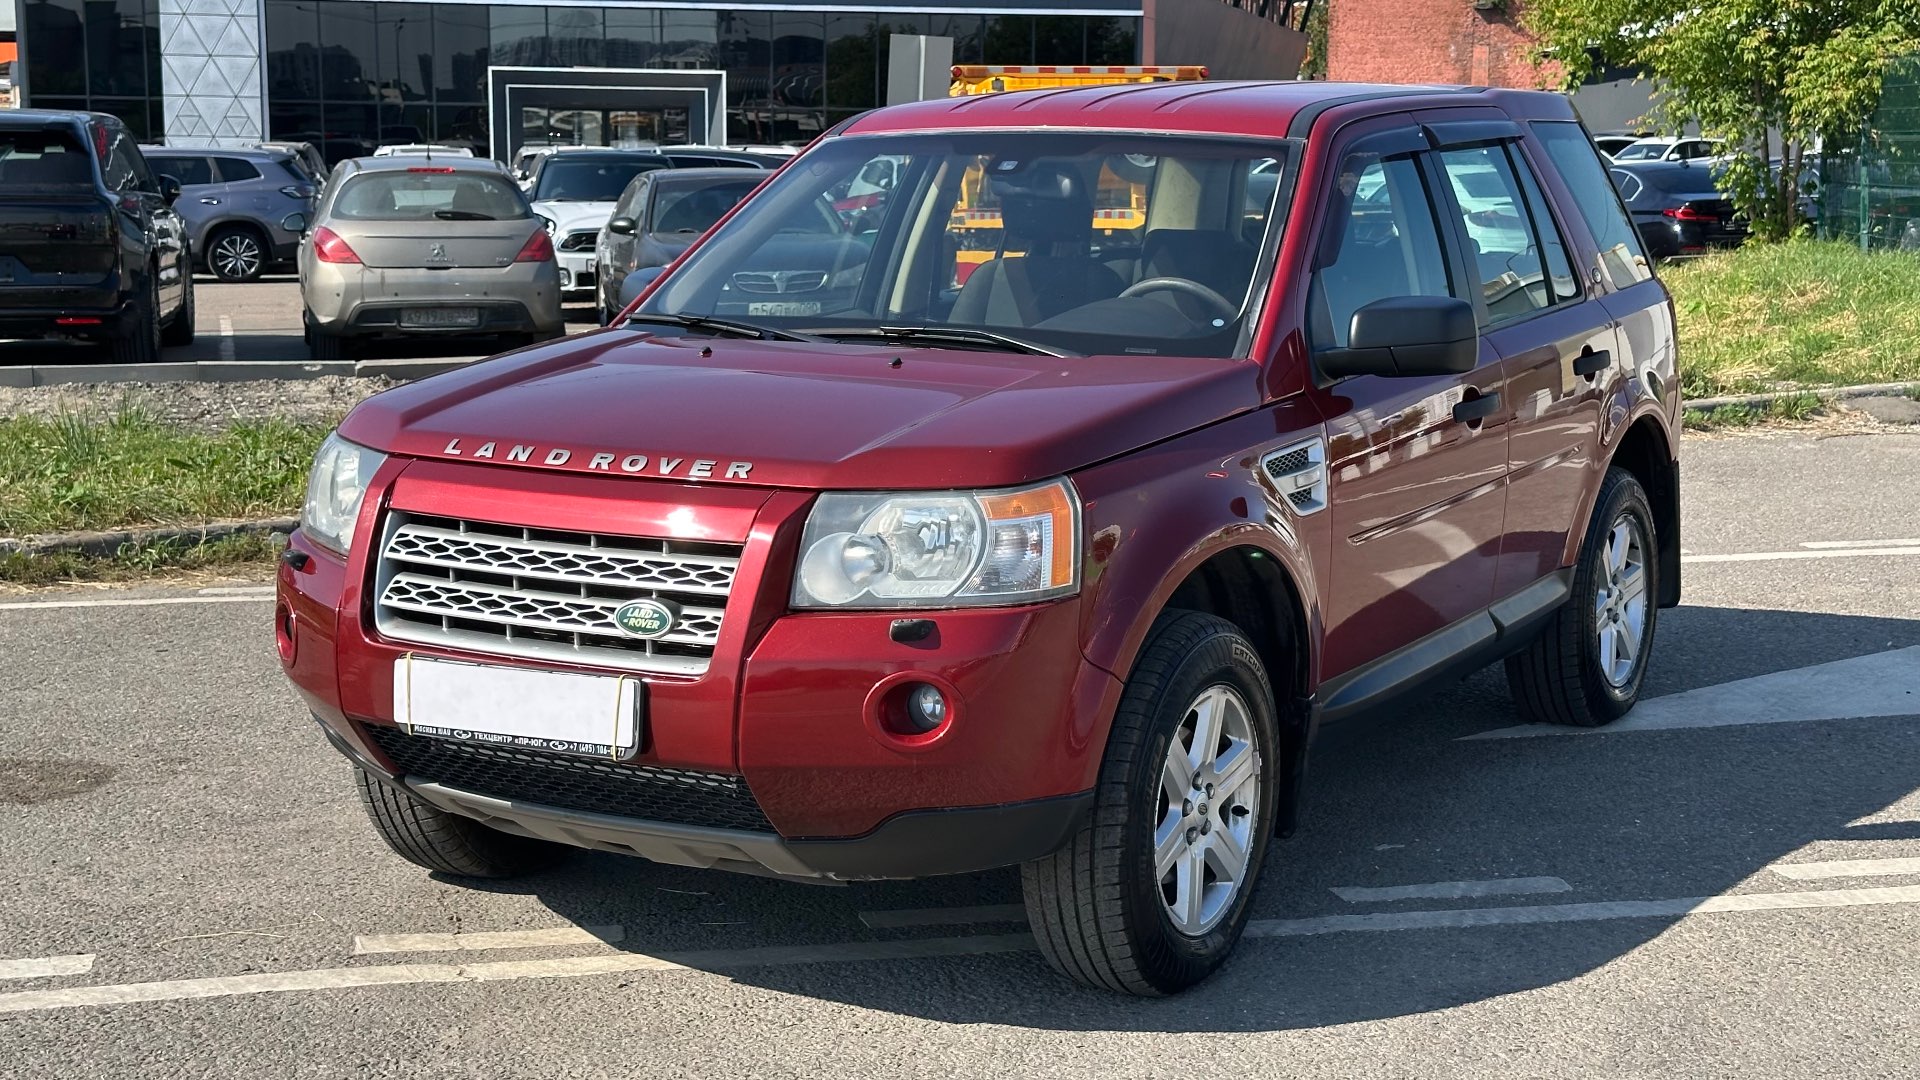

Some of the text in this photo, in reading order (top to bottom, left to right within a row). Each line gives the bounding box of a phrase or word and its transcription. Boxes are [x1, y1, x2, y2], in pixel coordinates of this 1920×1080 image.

[443, 438, 753, 480] LAND ROVER
[627, 608, 654, 619] LAND
[628, 617, 661, 630] ROVER
[414, 724, 437, 735] Москва
[474, 731, 513, 744] ТЕХЦЕНТР
[569, 743, 578, 752] +7
[579, 743, 596, 754] (495)
